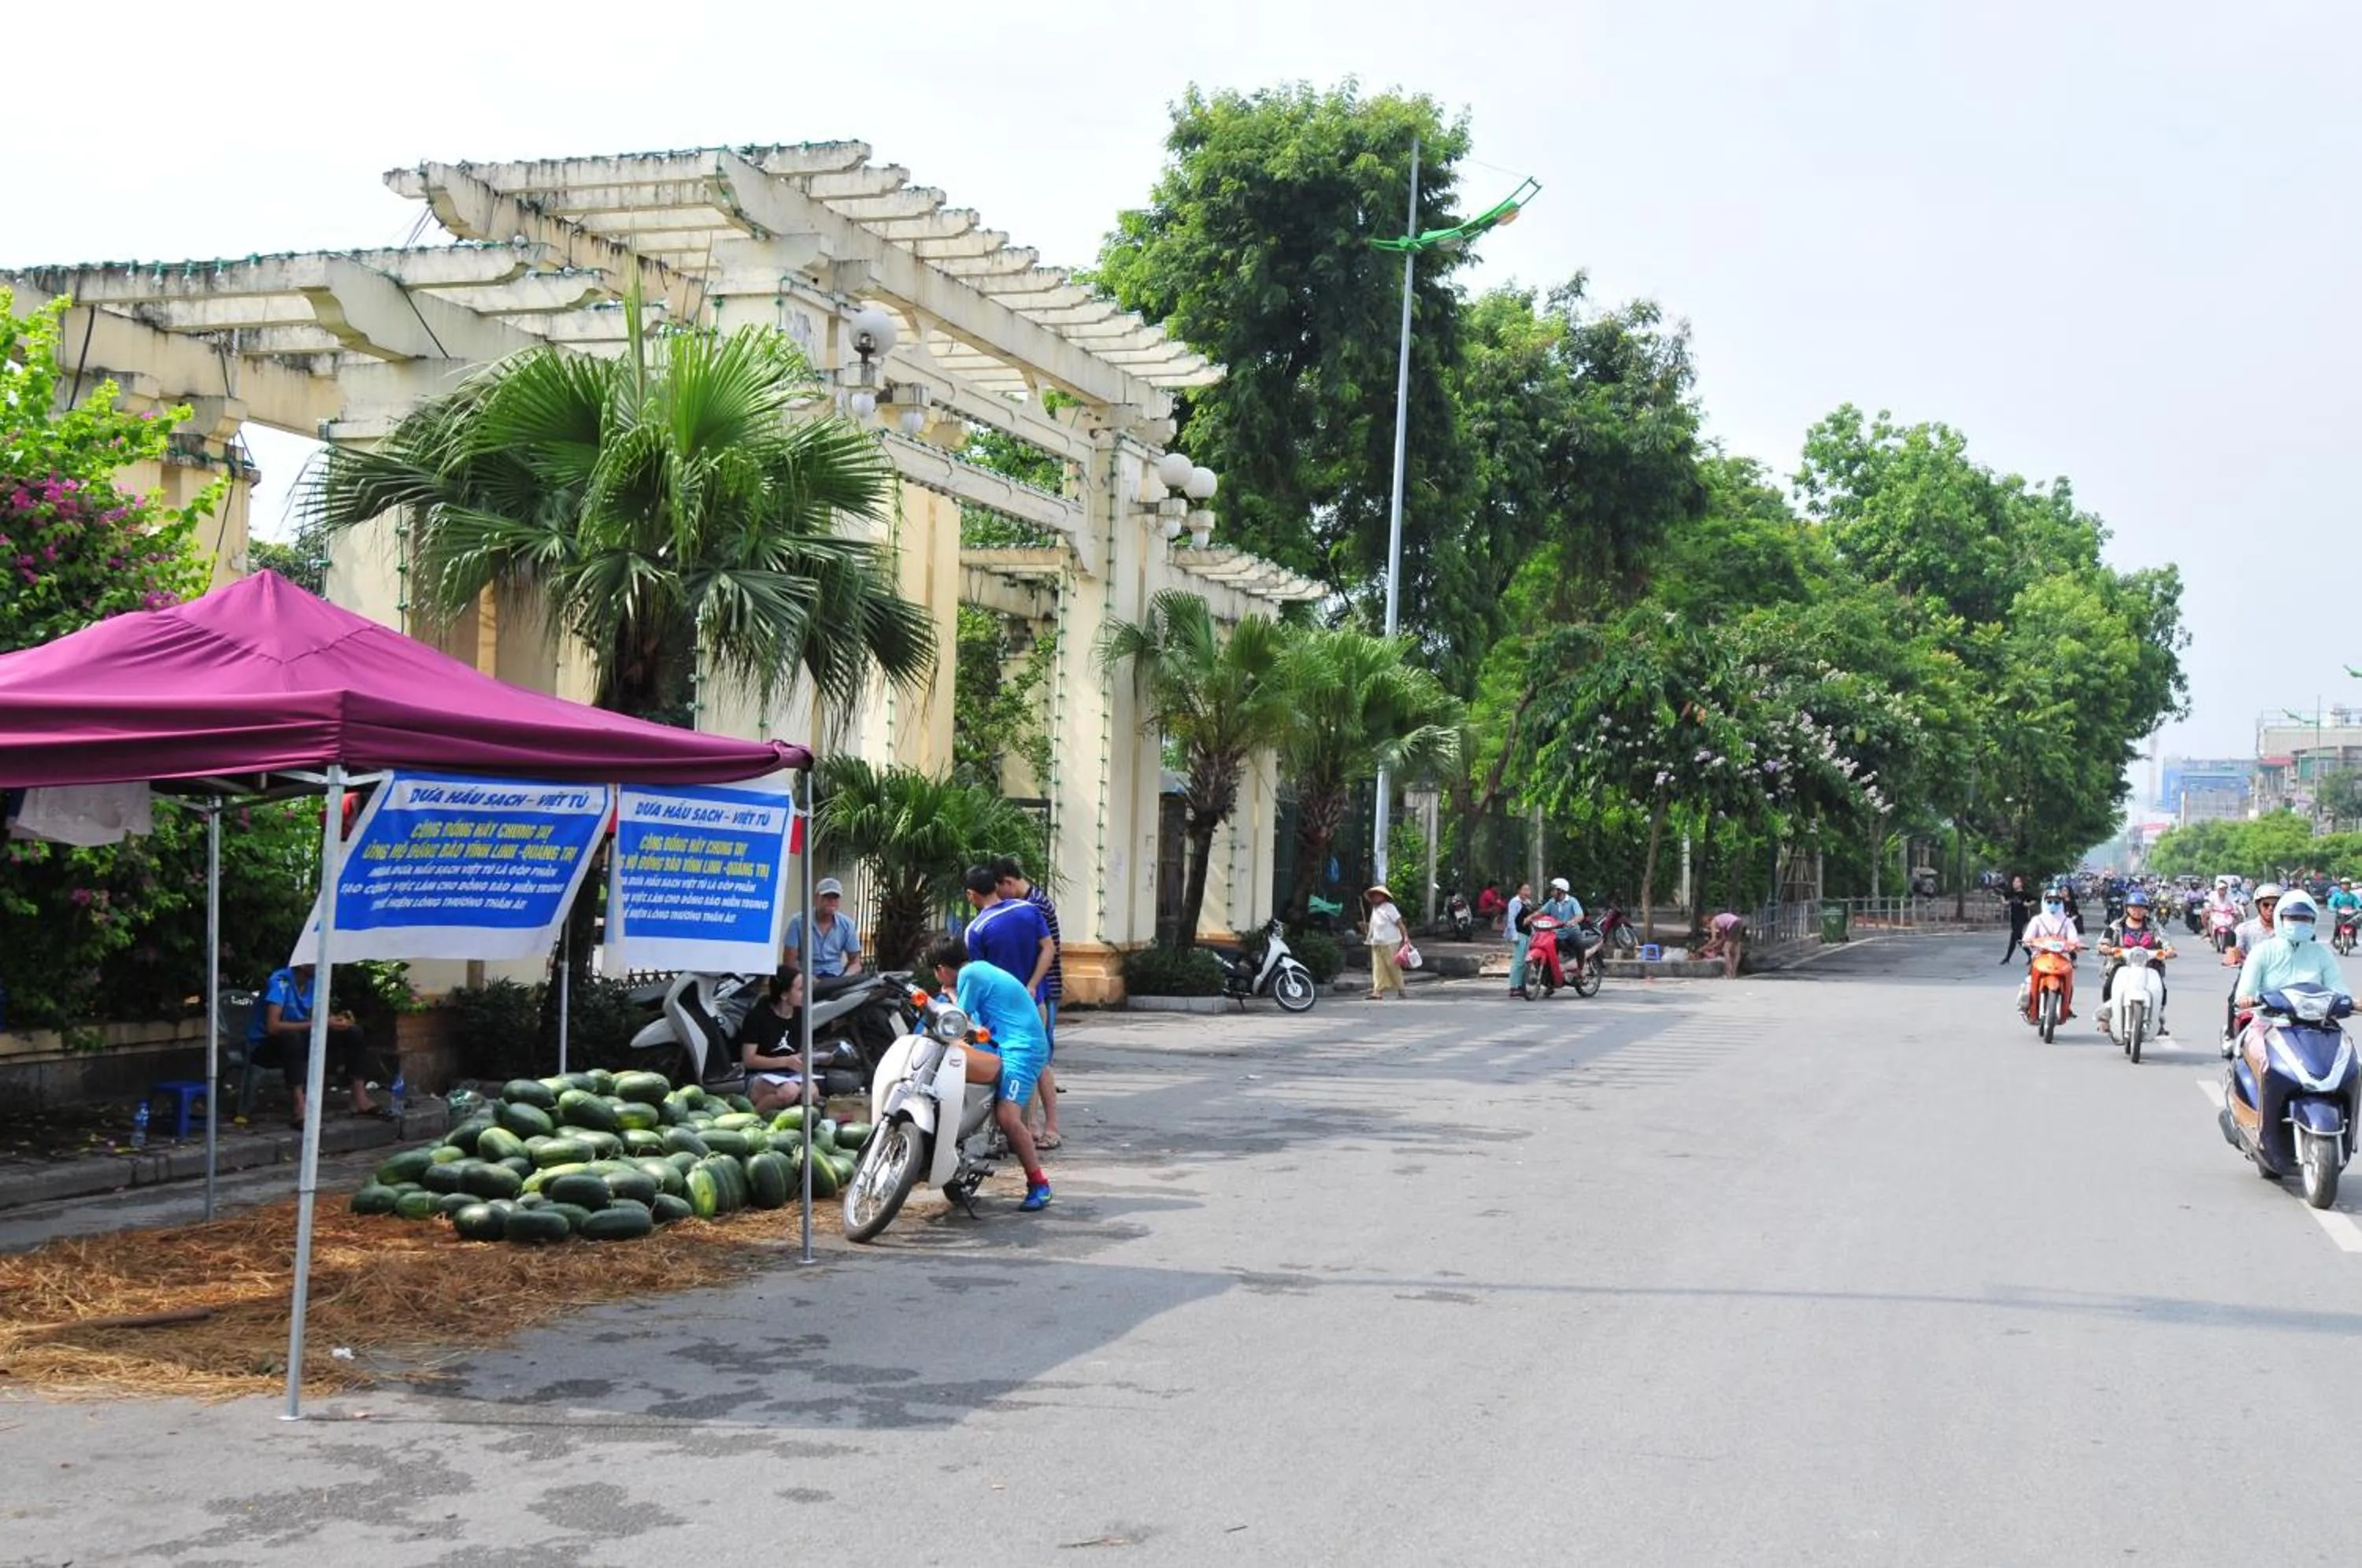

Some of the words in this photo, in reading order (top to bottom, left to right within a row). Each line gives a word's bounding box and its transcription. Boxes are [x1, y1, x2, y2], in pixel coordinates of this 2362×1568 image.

[482, 793, 528, 808] SẠCH
[536, 791, 568, 810] VIỆT
[691, 808, 724, 824] SẠCH
[1005, 1079, 1020, 1101] 9
